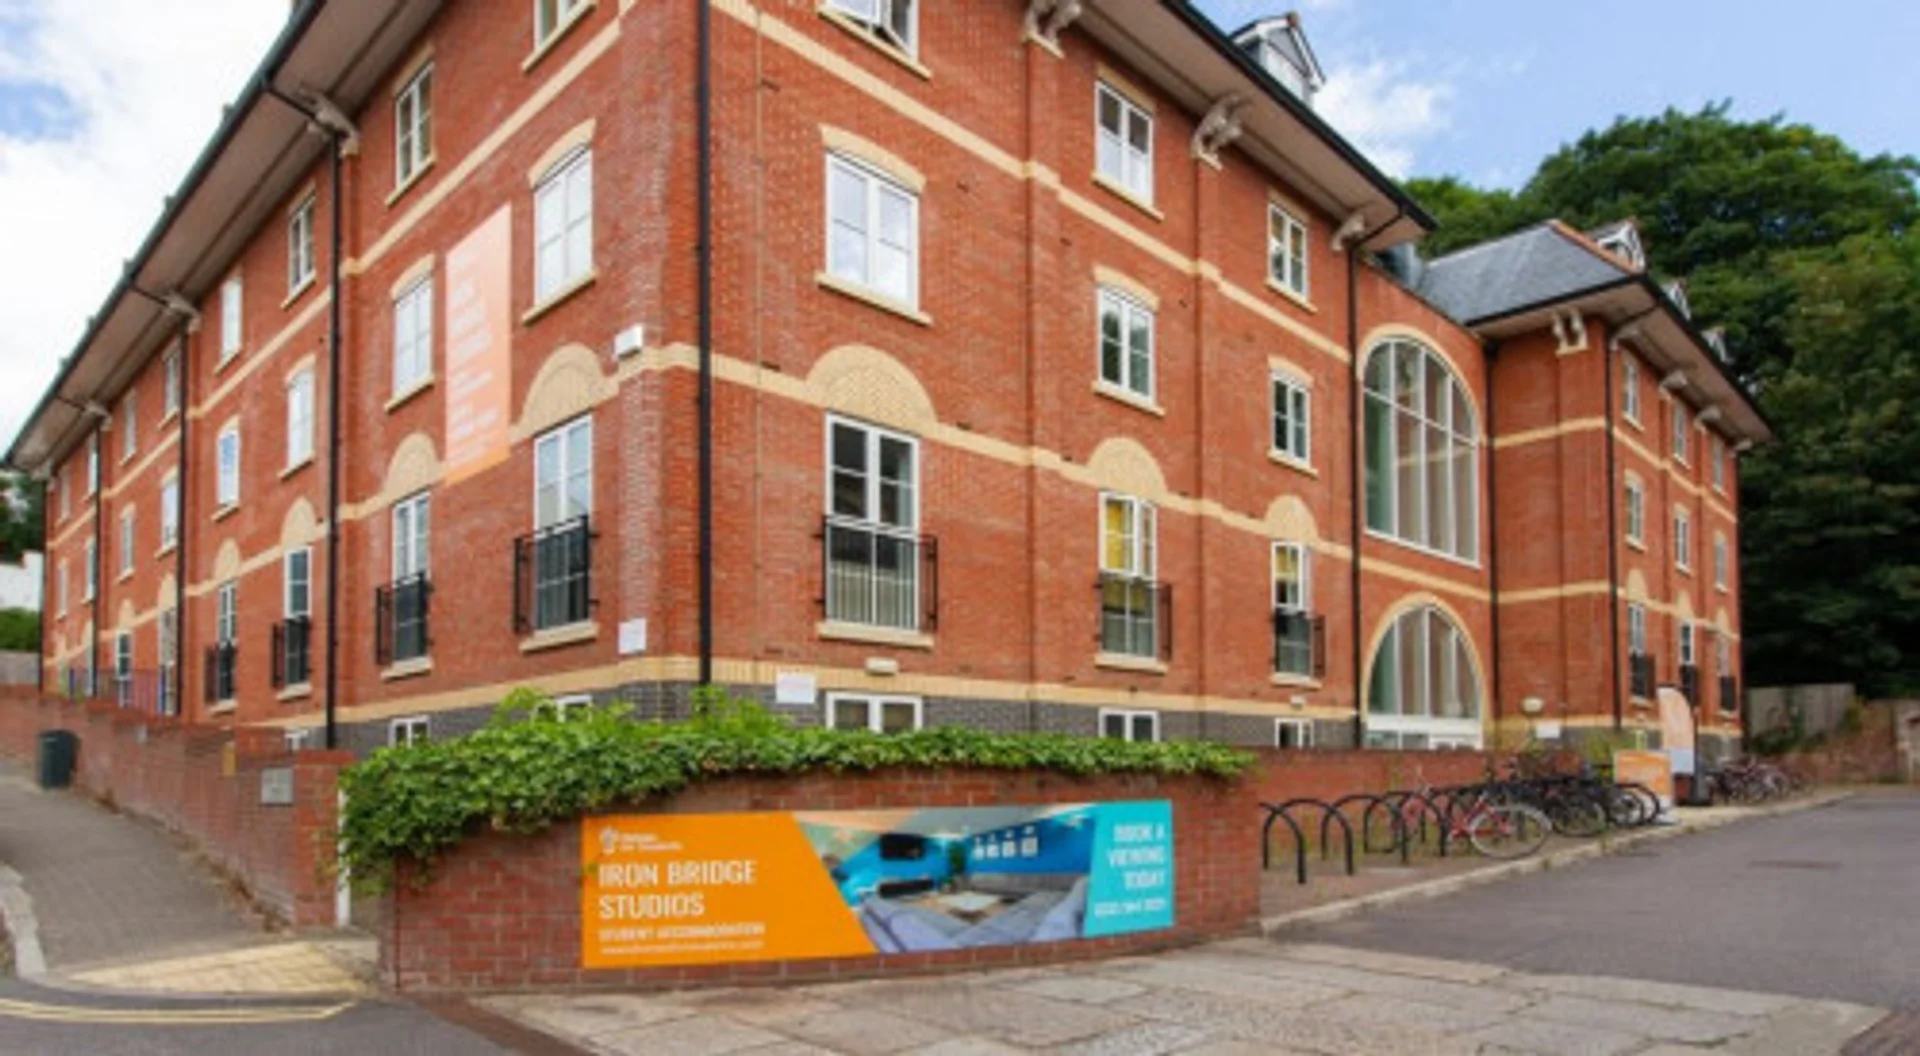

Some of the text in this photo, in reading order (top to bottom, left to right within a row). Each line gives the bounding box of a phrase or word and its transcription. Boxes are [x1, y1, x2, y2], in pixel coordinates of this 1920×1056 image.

[599, 860, 757, 887] IRON BRIDGE
[599, 892, 705, 919] STUDIOS
